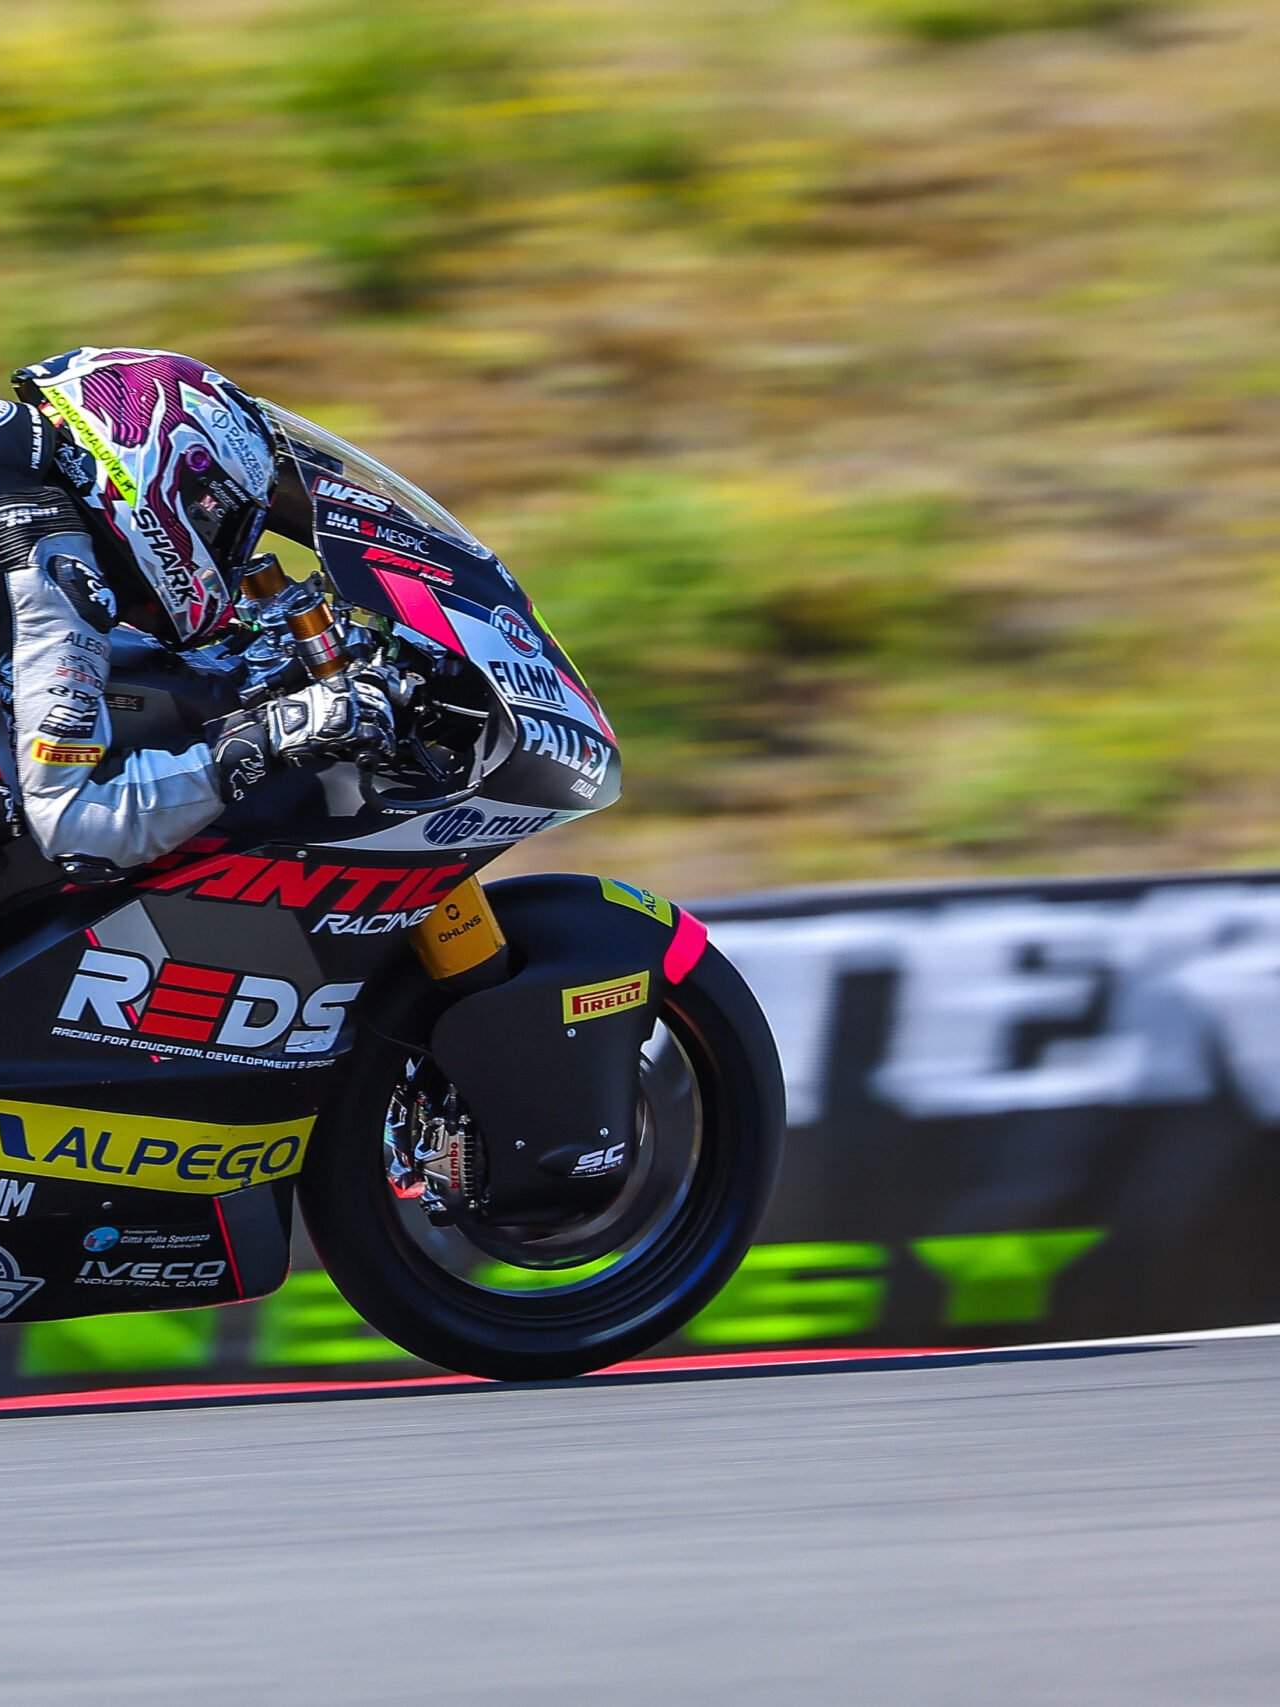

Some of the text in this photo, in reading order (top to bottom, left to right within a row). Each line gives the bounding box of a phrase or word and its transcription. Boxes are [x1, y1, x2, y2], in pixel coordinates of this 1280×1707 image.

[131, 508, 201, 606] SHARK
[375, 525, 430, 554] MESPIC
[361, 547, 455, 582] FANTIC
[494, 613, 539, 650] NILS
[488, 660, 566, 704] FIAMM
[36, 742, 102, 764] PIRELLI
[518, 713, 612, 786] PALLEX
[570, 778, 598, 800] ITALIA
[311, 904, 439, 935] RACING
[437, 915, 483, 943] ÖHLINS
[57, 948, 366, 1054] REDS
[571, 981, 642, 1016] PIRELLI
[50, 1026, 103, 1042] RACING
[102, 1035, 130, 1047] FOR
[130, 1039, 204, 1060] EDUCATION,
[205, 1051, 298, 1070] DEVELOPMENT
[41, 1126, 301, 1182] ALPEGO
[450, 1142, 461, 1191] brembo
[573, 1142, 626, 1171] SC
[74, 1277, 220, 1288] INDUSTRIAL CARS
[78, 1260, 227, 1280] IVECO
